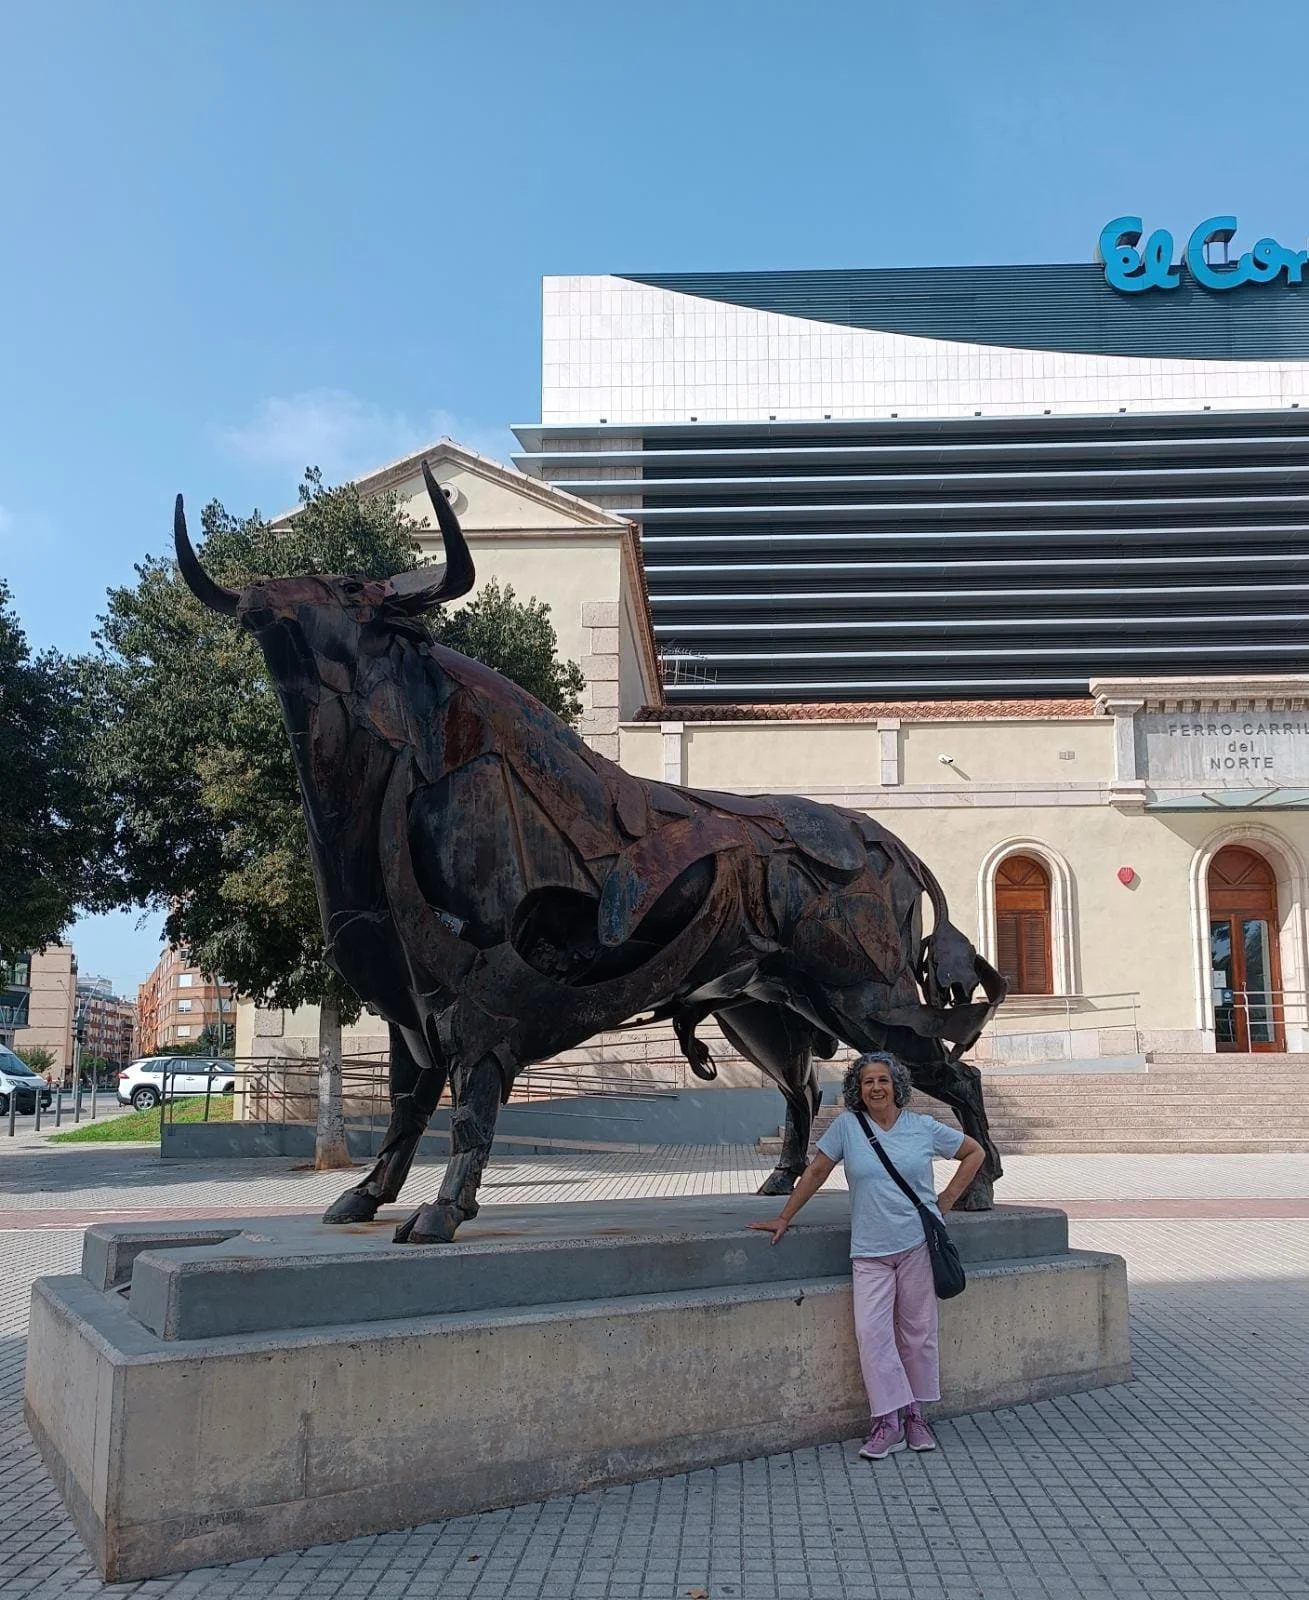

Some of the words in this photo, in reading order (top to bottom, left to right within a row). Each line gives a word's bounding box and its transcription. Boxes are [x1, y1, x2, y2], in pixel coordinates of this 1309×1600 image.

[1100, 216, 1180, 292] El
[1228, 741, 1254, 752] del
[1210, 757, 1274, 769] NORTE
